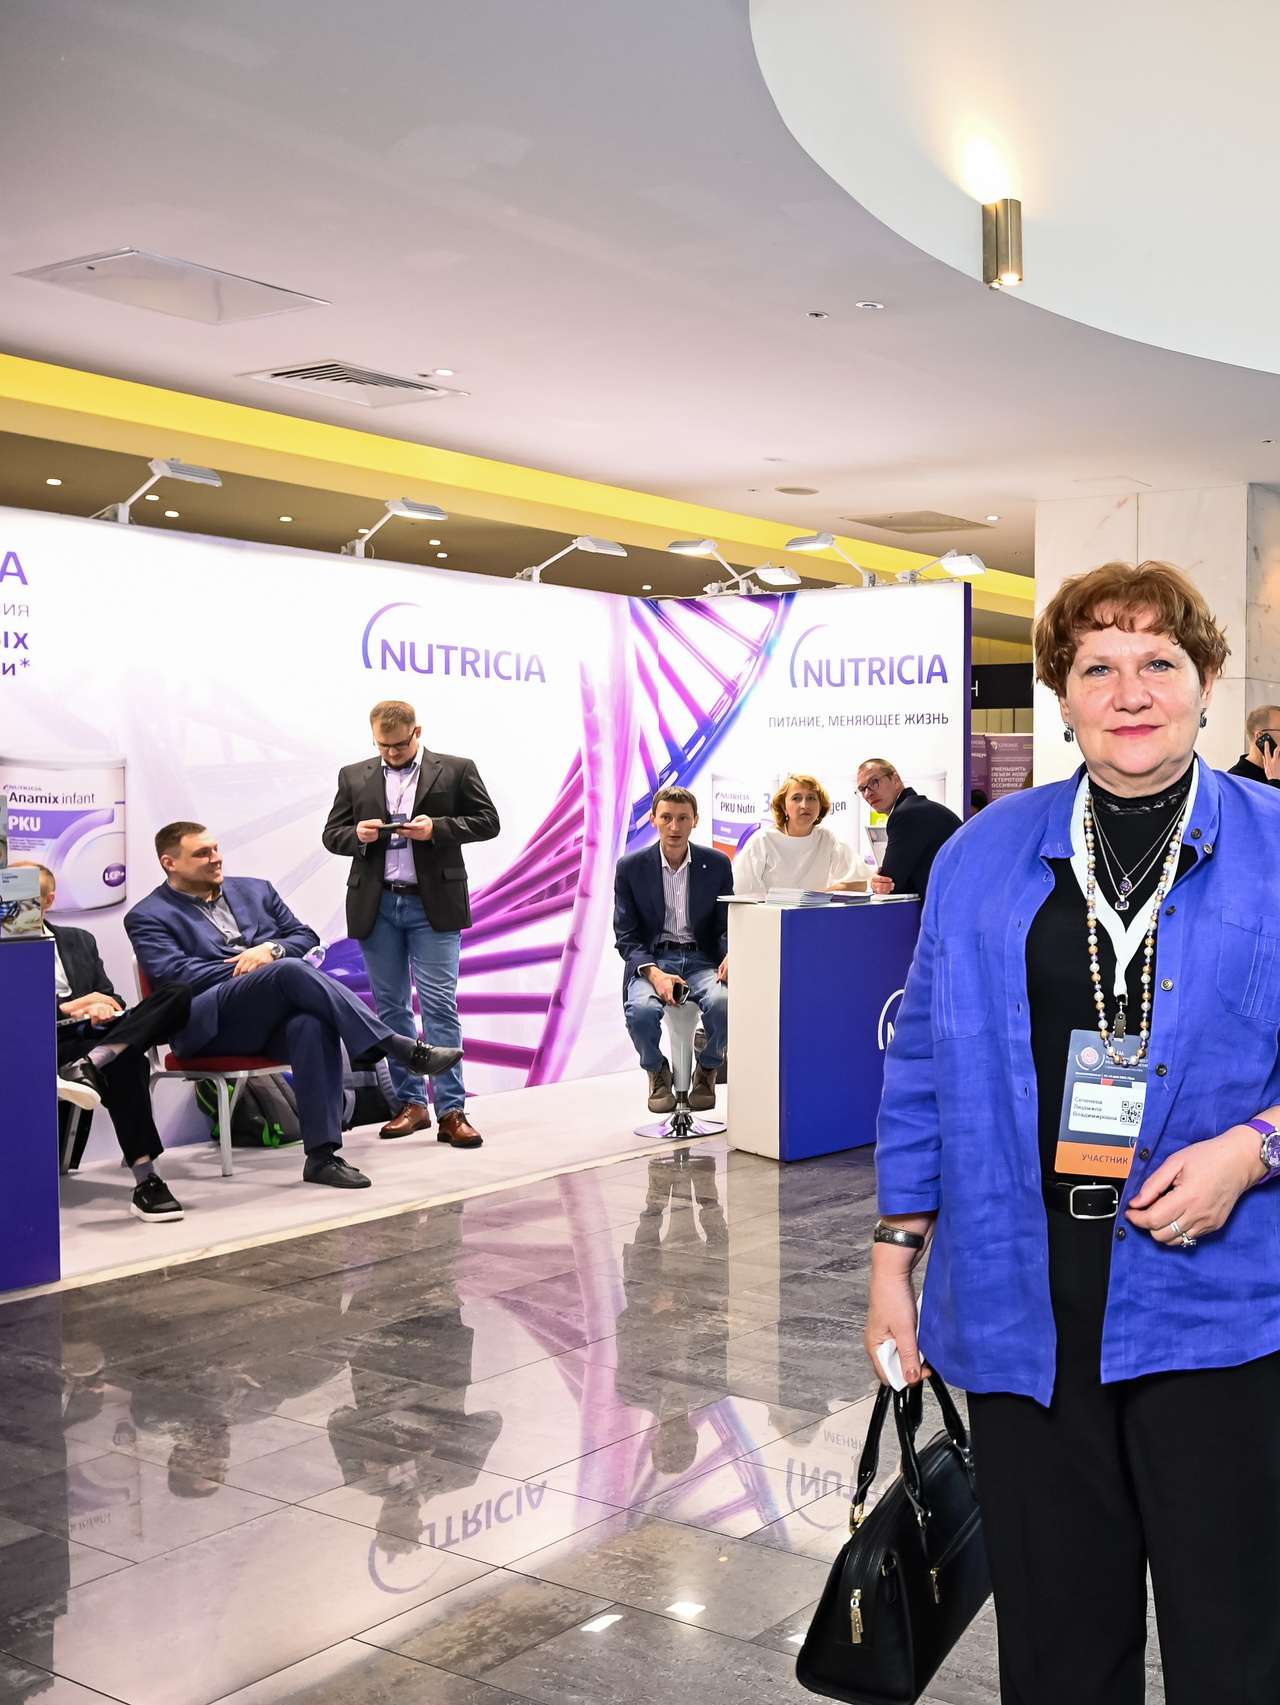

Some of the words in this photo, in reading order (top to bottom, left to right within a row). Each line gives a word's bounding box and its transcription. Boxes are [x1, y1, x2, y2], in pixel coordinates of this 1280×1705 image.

[381, 638, 546, 683] NUTRICIA
[803, 654, 949, 688] NUTRICIA
[768, 716, 825, 729] ПИТАНИЕ,
[828, 714, 900, 729] МЕНЯЮЩЕЕ
[904, 712, 949, 726] ЖИЗНЬ
[9, 791, 59, 804] Anamix
[62, 792, 95, 804] infant
[720, 792, 750, 800] NUTRICIA
[720, 801, 736, 813] PKU
[736, 802, 756, 814] Nutri
[8, 815, 41, 832] PKU
[1072, 1111, 1118, 1121] Владимировна
[1081, 1153, 1129, 1165] УЧАСТНИК
